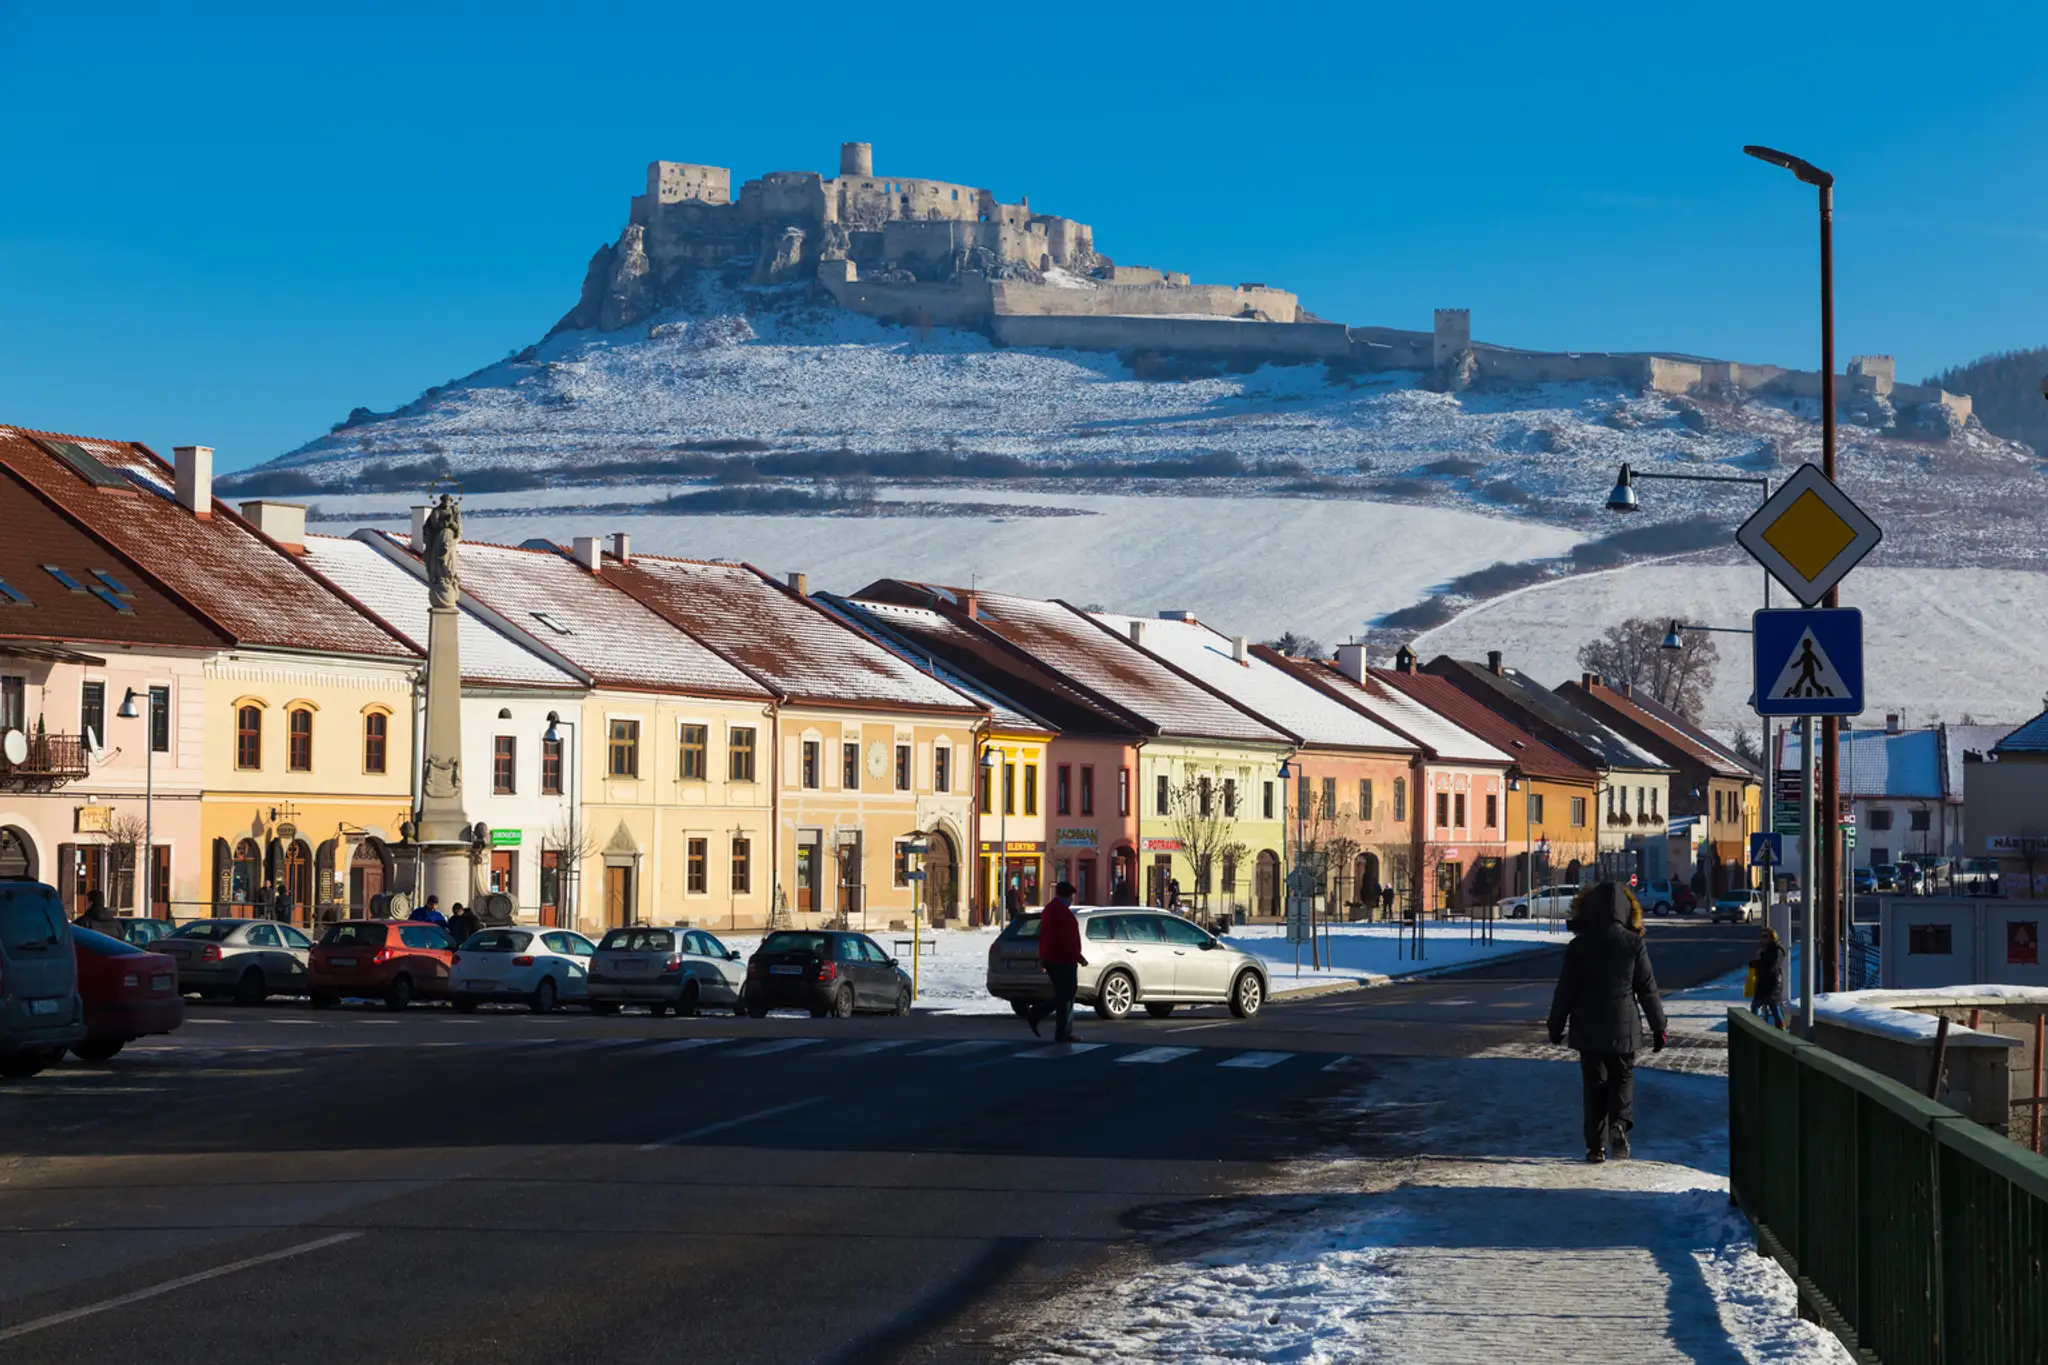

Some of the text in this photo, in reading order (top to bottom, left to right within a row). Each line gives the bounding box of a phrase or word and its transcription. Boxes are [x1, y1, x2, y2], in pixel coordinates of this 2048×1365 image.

[1056, 828, 1097, 845] FACHMAN
[1994, 836, 2048, 848] NÁBYT
[1007, 843, 1036, 851] ELEKTRO
